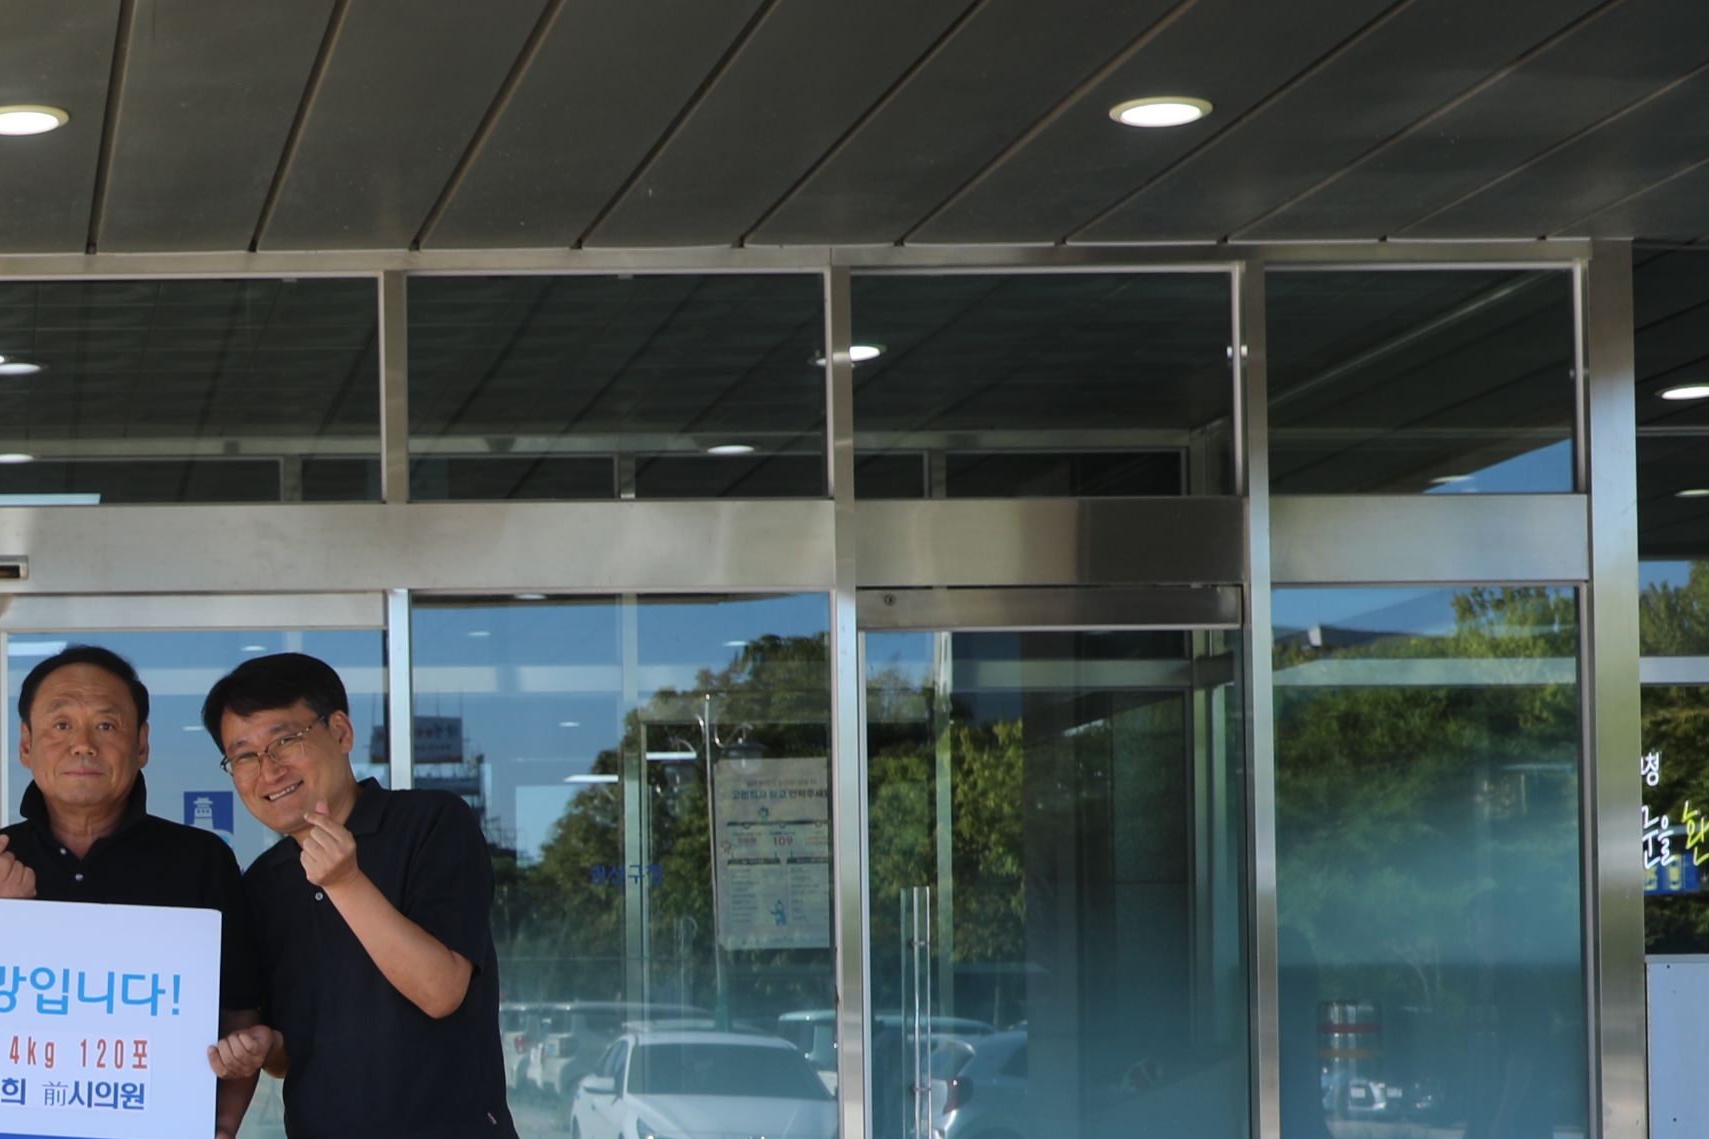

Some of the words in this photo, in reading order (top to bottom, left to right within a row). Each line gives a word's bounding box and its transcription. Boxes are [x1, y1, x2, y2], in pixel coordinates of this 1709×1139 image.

[774, 836, 794, 847] 109
[589, 863, 664, 886] 권선구청
[9, 1034, 56, 1069] 4kg
[80, 1037, 149, 1071] 120포
[42, 1081, 145, 1110] 前시의원
